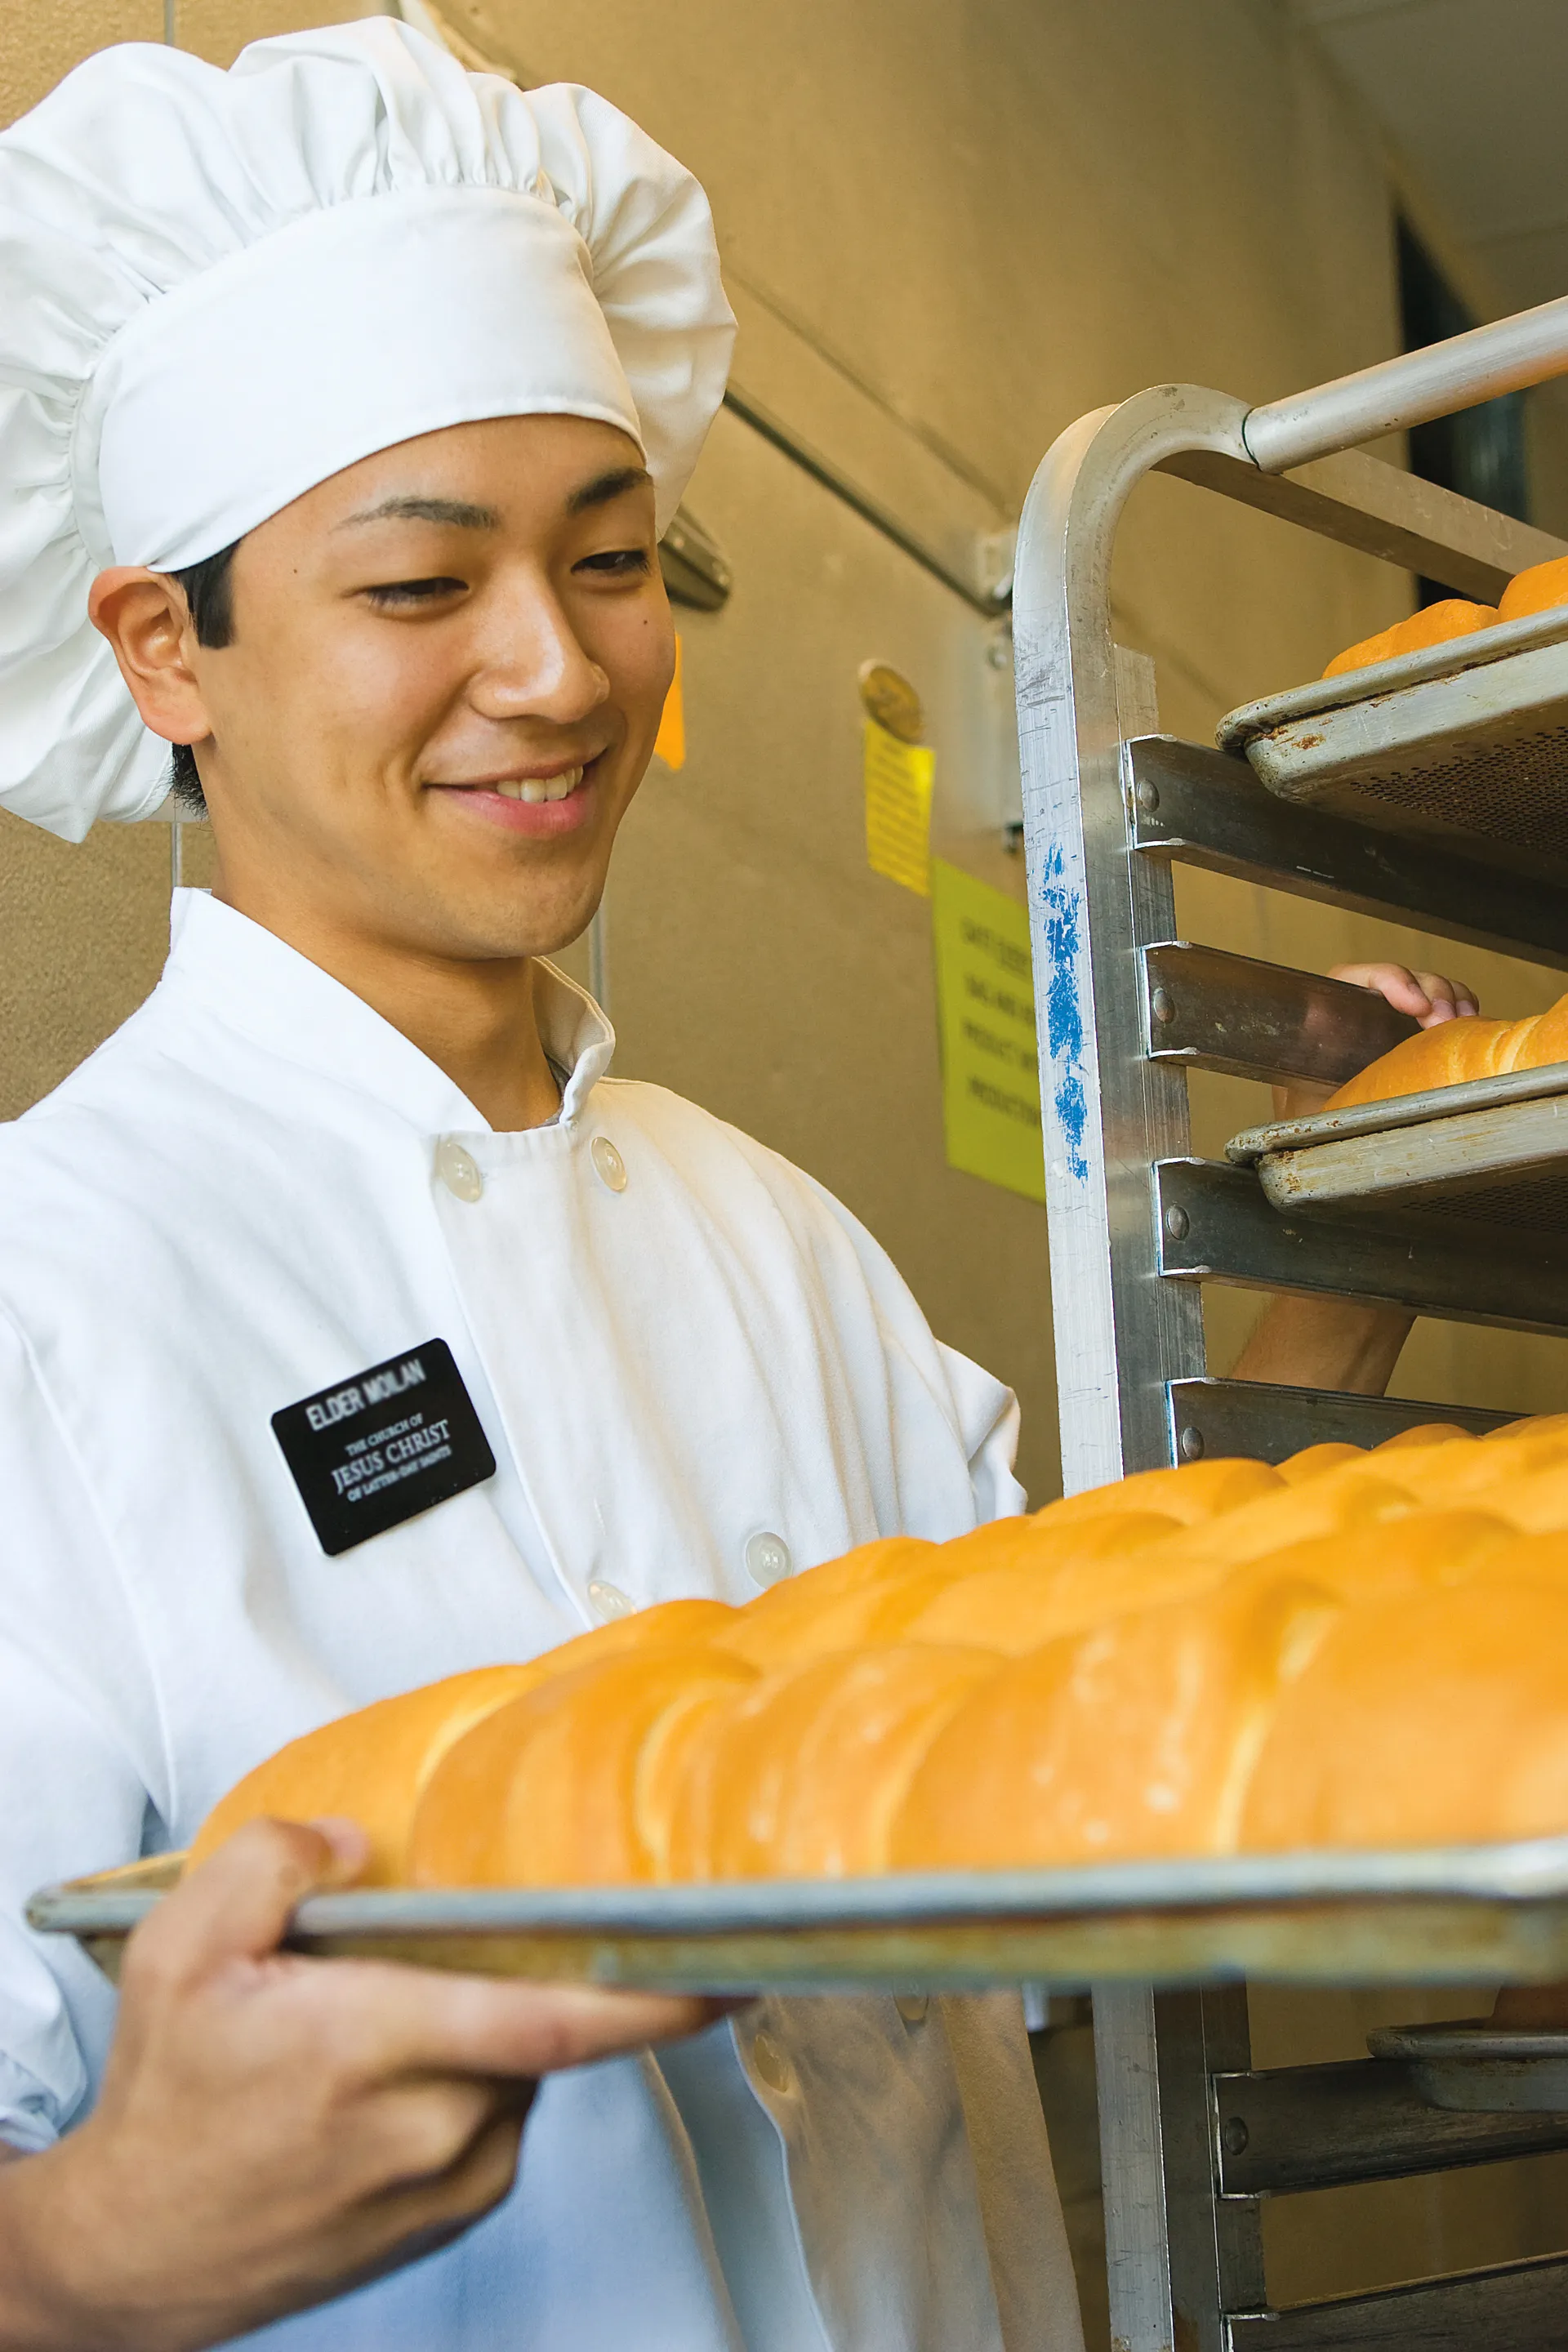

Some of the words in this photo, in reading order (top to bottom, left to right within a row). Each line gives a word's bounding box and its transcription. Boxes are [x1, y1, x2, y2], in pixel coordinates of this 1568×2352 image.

[305, 1388, 365, 1431] ELDER
[345, 1439, 368, 1456] THE
[368, 1420, 410, 1446] CHURCH
[409, 1413, 423, 1427] OF
[331, 1451, 385, 1494] JESUS
[385, 1419, 450, 1463] CHRIST
